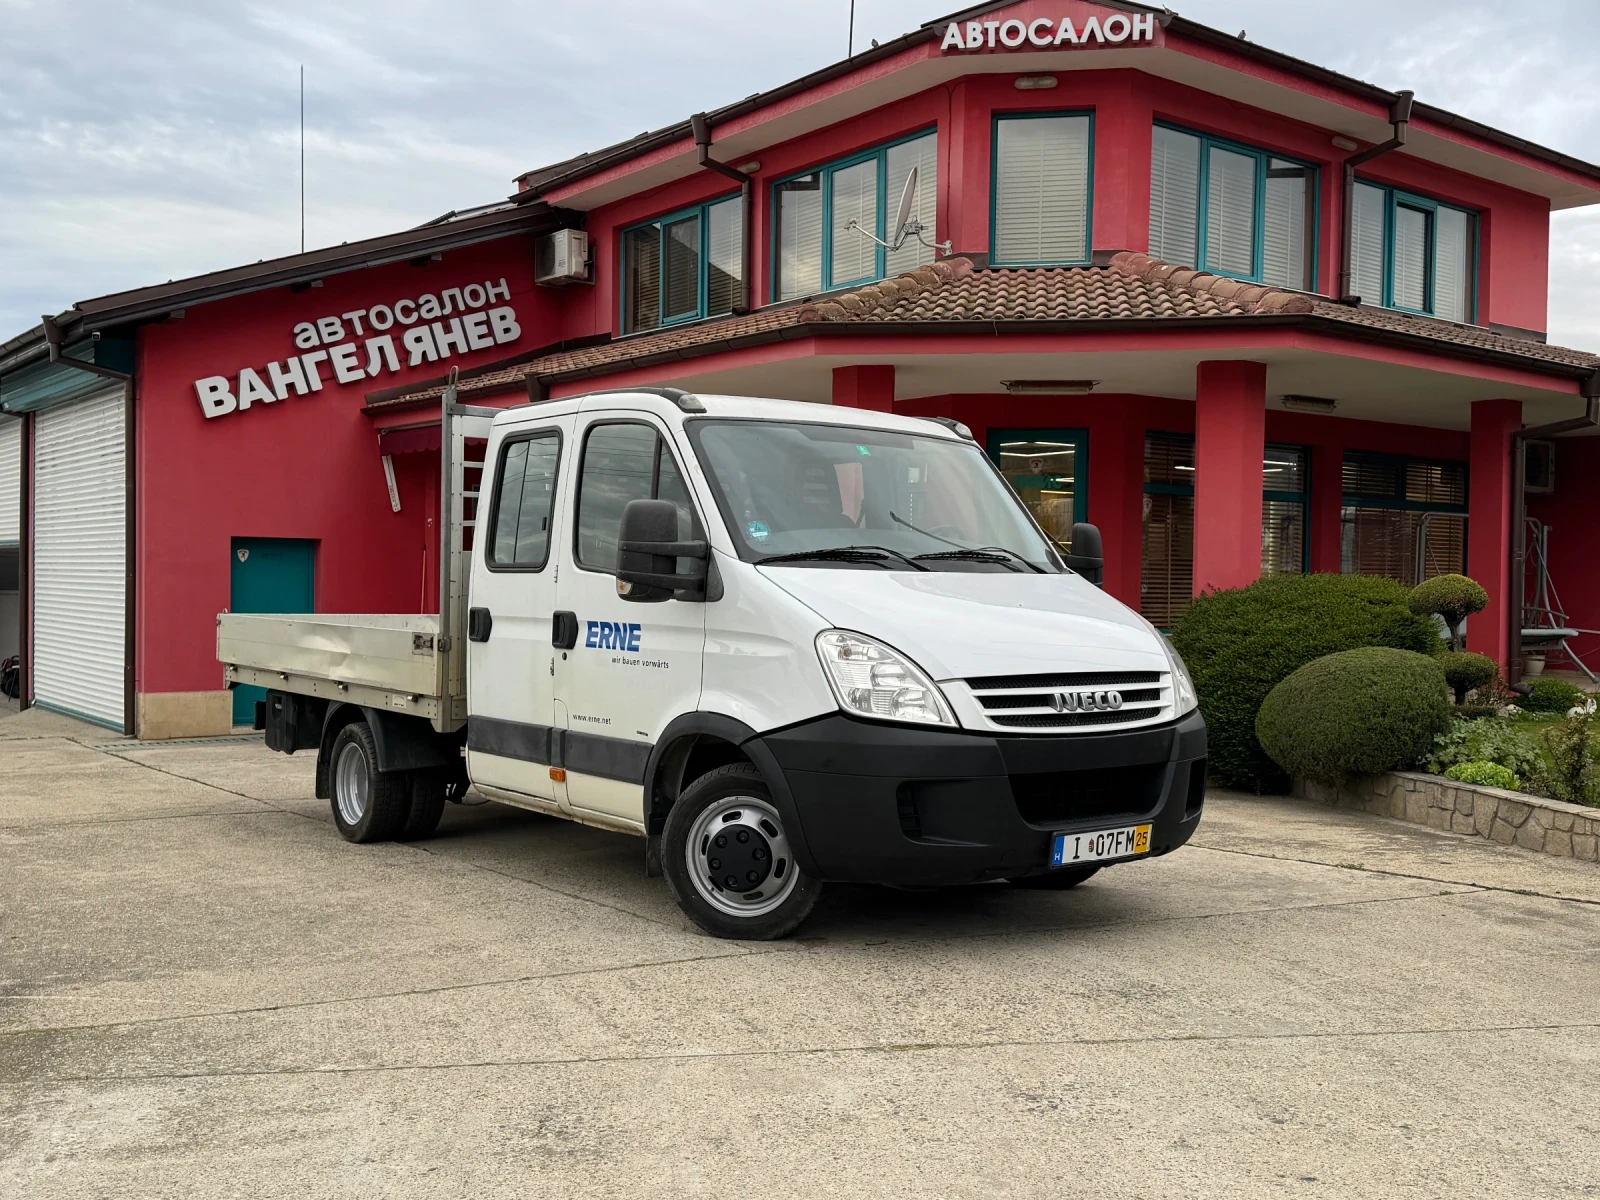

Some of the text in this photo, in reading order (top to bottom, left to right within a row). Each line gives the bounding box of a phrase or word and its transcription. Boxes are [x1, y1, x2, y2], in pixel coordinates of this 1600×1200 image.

[940, 13, 1154, 50] АВТОСАЛОН
[293, 277, 511, 349] автосалон
[193, 306, 521, 419] ВАНГЕЛ ЯНЕВ
[585, 620, 642, 652] ERNE
[611, 656, 669, 669] wir bauen vorwärts
[1051, 690, 1123, 712] IVECO
[572, 713, 612, 725] www.erne.net
